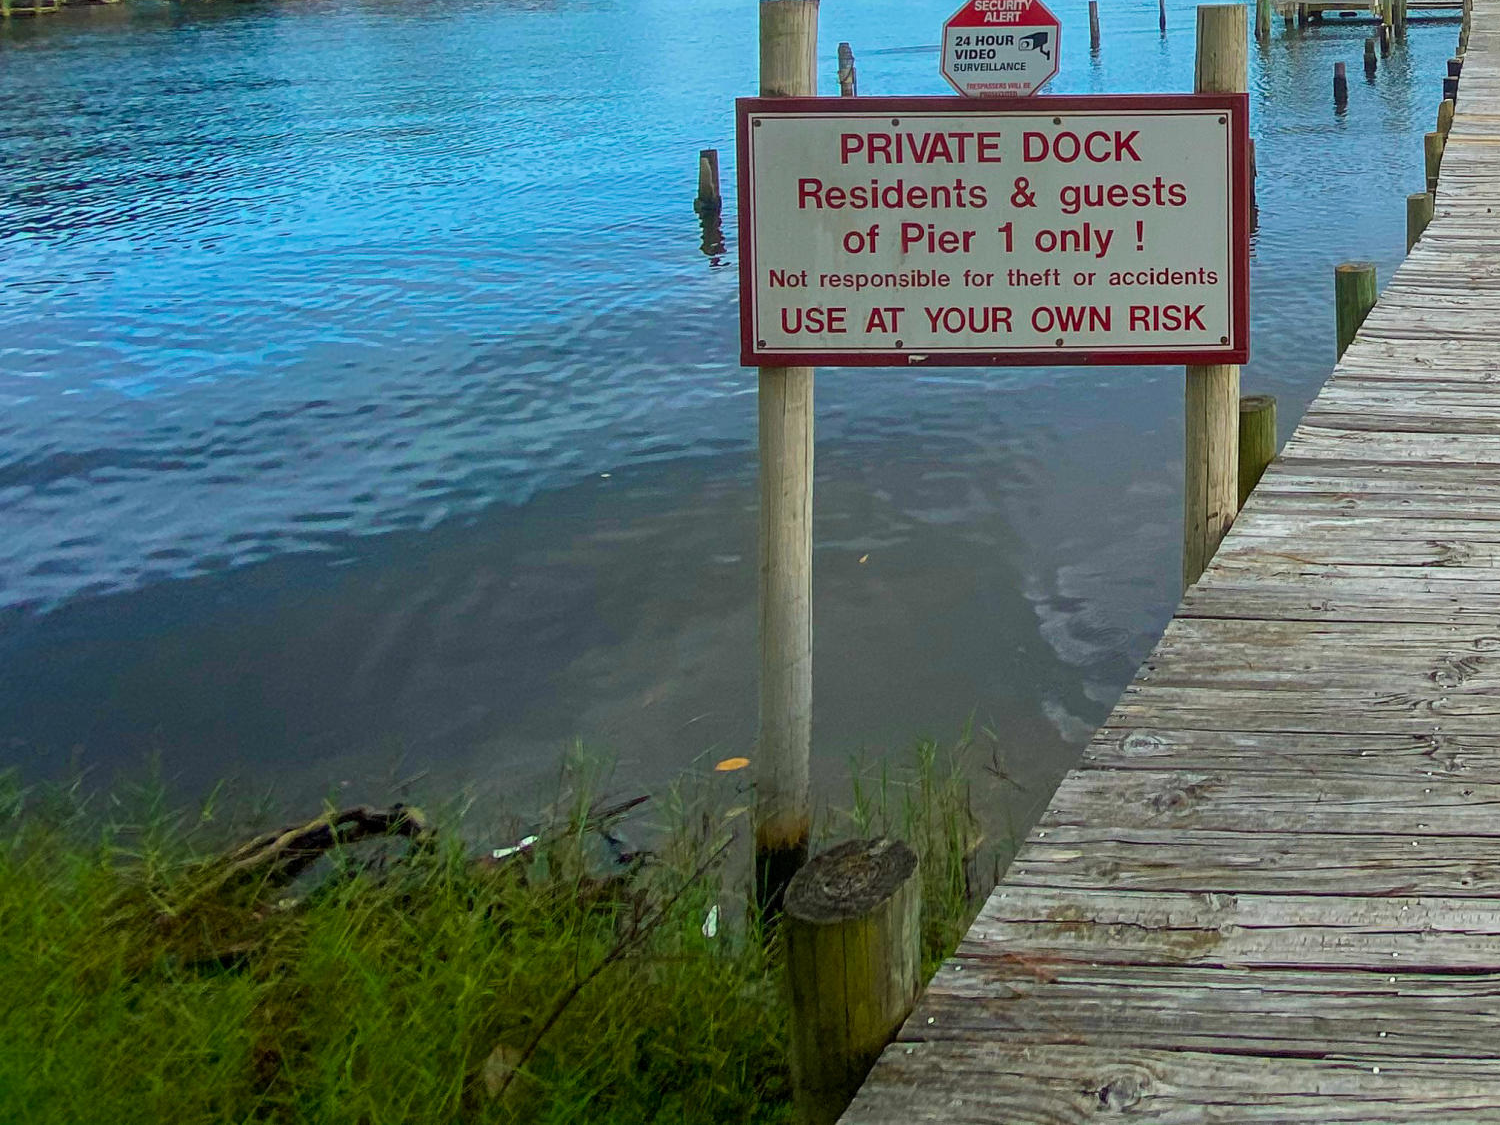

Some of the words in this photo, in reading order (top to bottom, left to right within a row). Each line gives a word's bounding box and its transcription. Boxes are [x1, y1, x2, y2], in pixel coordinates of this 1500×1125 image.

[974, 0, 1033, 11] SECURITY
[984, 11, 1021, 23] ALERT
[955, 36, 970, 46] 24
[975, 35, 1014, 46] HOUR
[954, 48, 996, 60] VIDEO
[953, 62, 1026, 72] SURVEILLANCE
[840, 131, 1001, 165] PRIVATE
[1023, 130, 1141, 163] DOCK
[799, 177, 988, 210] Residents
[1010, 177, 1036, 208] &
[1060, 176, 1187, 214] guests
[843, 224, 879, 254] of
[901, 222, 976, 254] Pier
[998, 222, 1013, 252] 1
[1035, 222, 1114, 259] only
[1136, 220, 1145, 250] !
[769, 269, 808, 288] Not
[820, 269, 951, 291] responsible
[963, 269, 994, 287] for
[1007, 269, 1060, 286] theft
[1073, 272, 1095, 286] or
[1108, 268, 1219, 286] accidents
[781, 307, 847, 334] USE
[865, 307, 904, 333] AT
[924, 306, 1013, 333] YOUR
[1030, 306, 1111, 333] OWN
[1128, 305, 1206, 332] RISK
